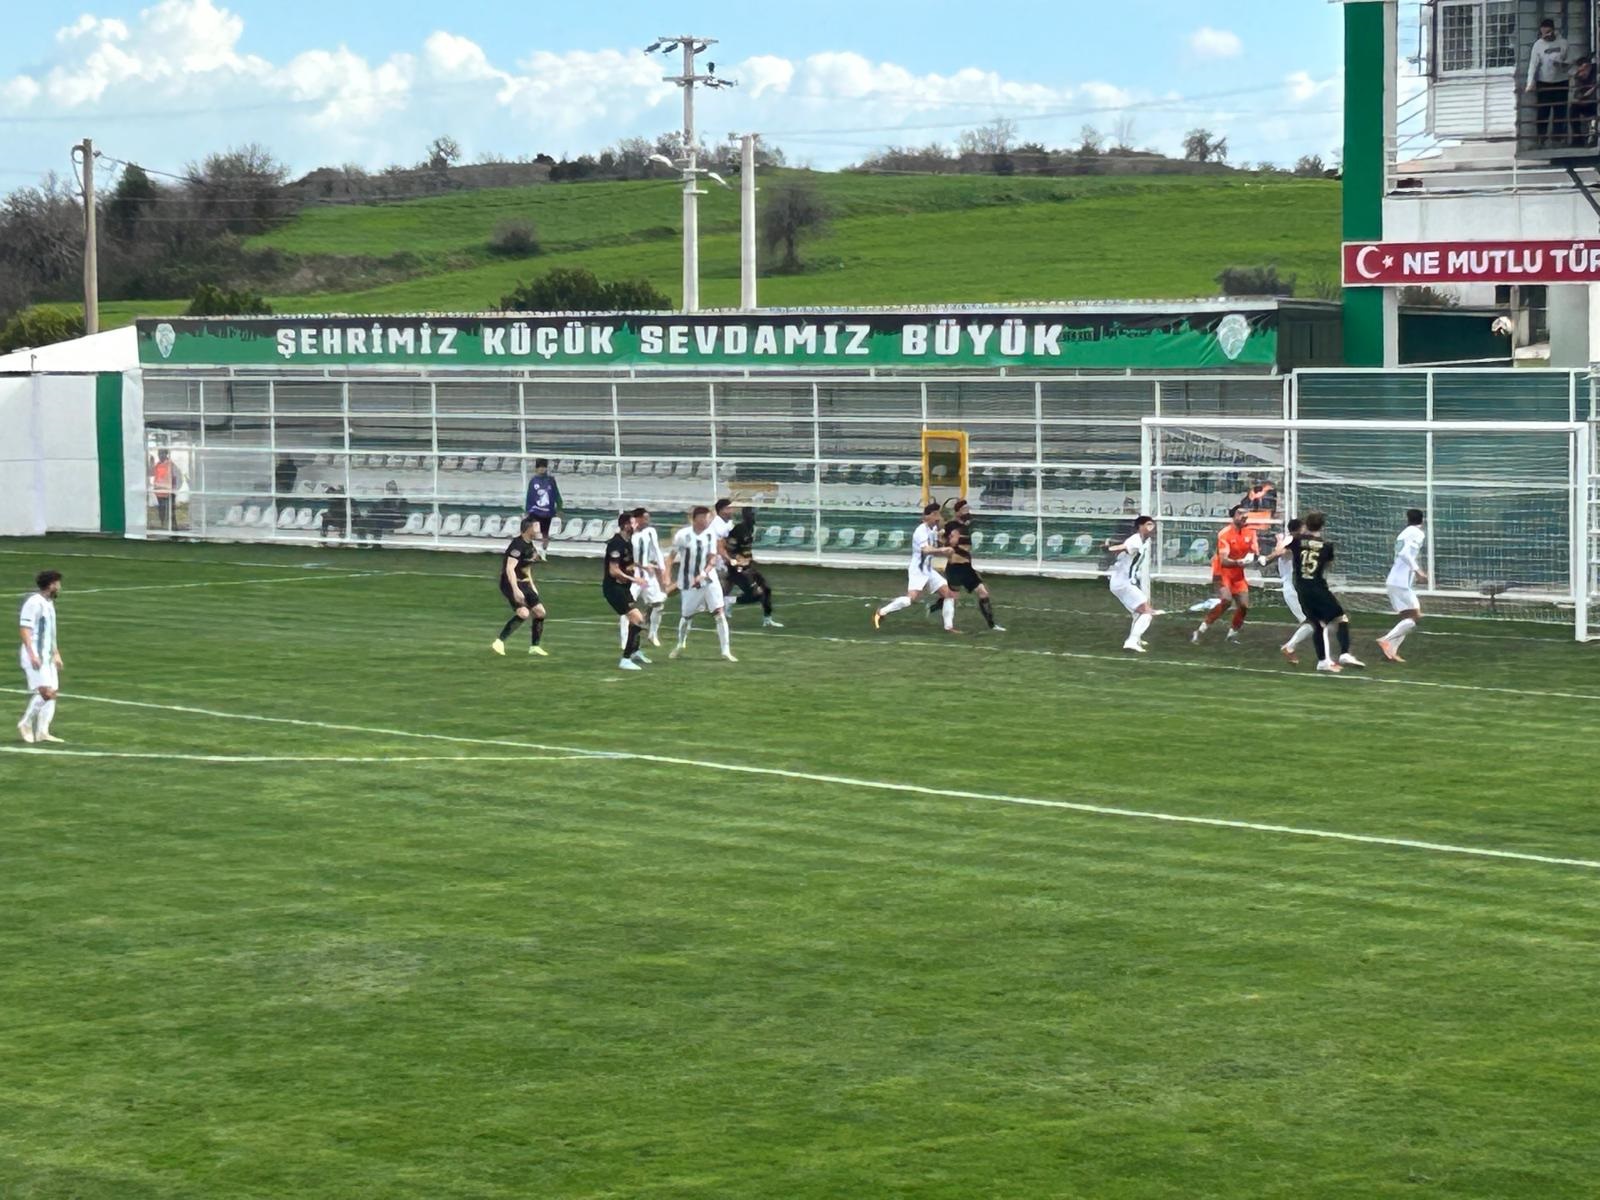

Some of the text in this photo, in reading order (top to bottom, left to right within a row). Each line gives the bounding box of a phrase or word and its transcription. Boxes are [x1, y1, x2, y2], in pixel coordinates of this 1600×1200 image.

[1403, 251, 1440, 275] NE
[1447, 249, 1542, 274] MUTLU
[276, 319, 1063, 359] ŞEHRİMİZ KÜÇÜK SEVDAMIZ BÜYÜK
[1301, 549, 1320, 573] 15
